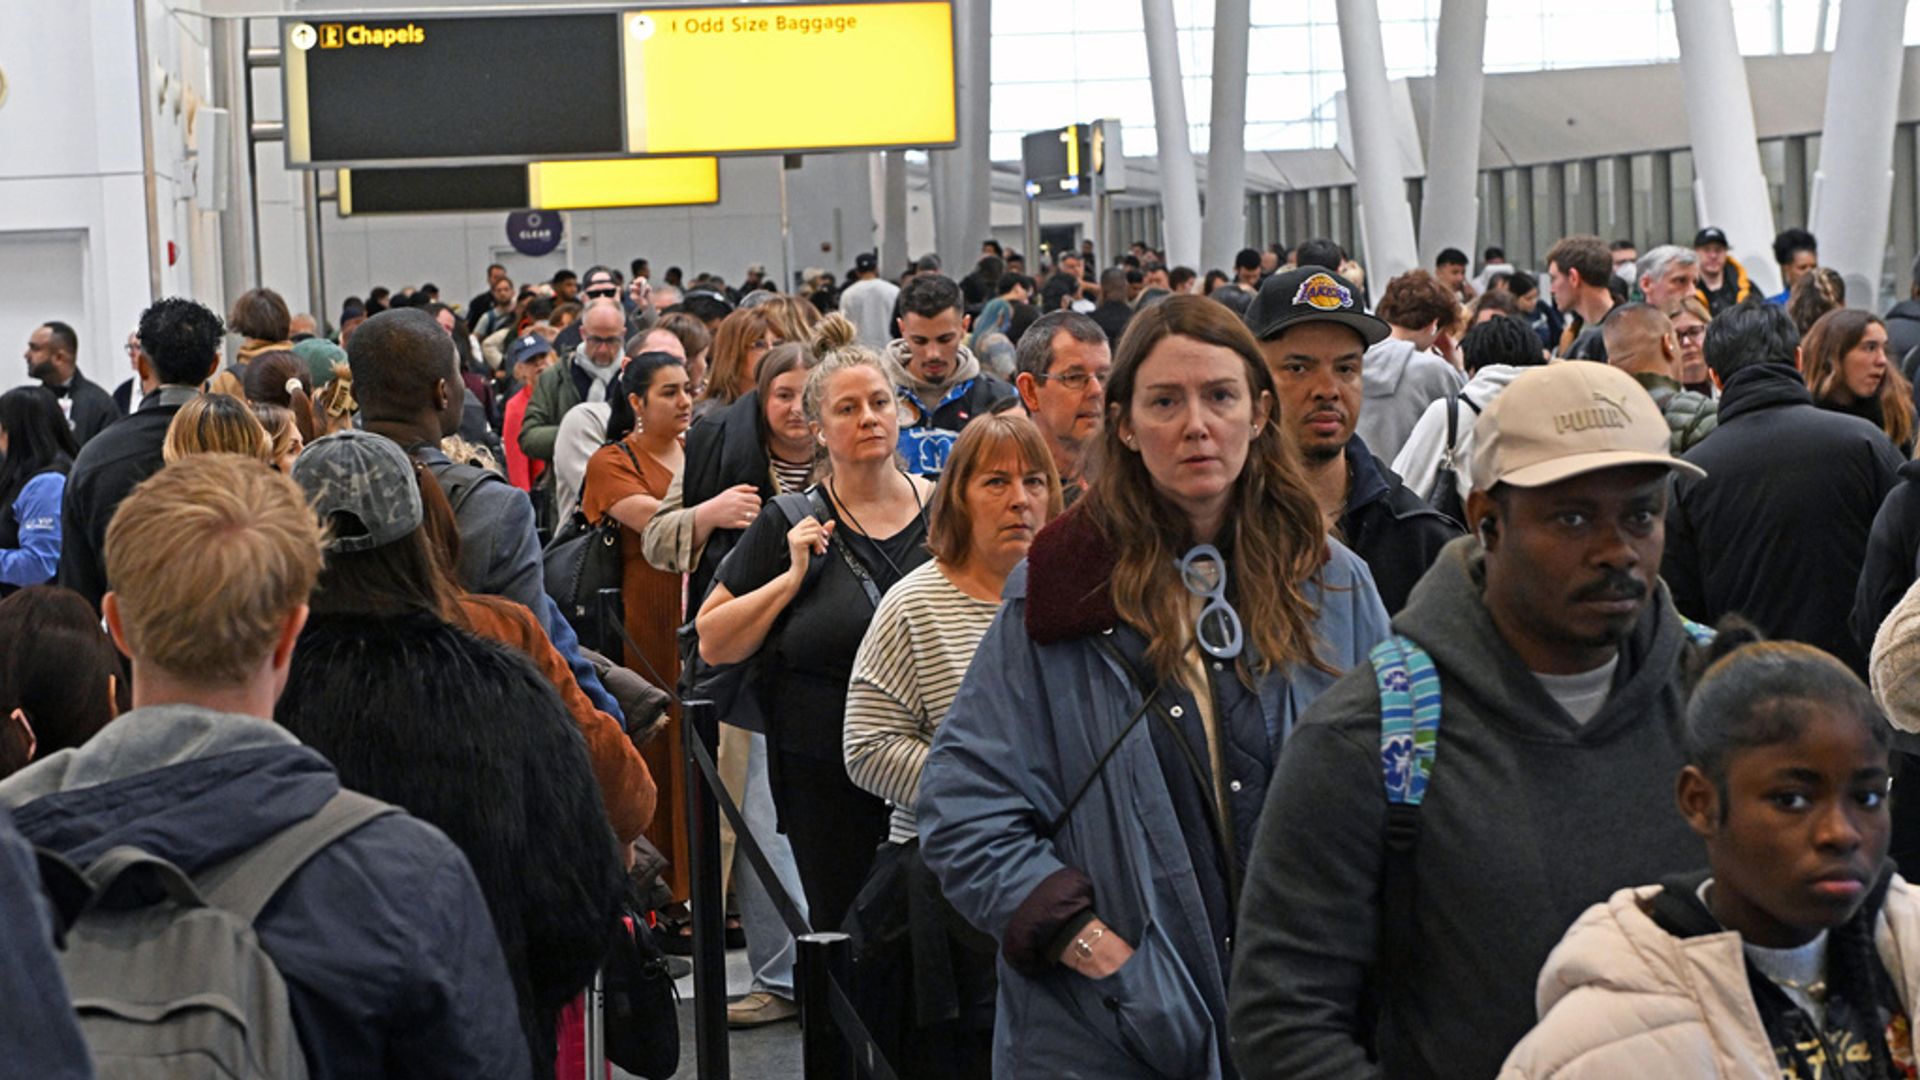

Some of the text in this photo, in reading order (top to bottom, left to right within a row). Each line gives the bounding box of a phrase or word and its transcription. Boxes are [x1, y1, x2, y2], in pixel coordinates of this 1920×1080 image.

[346, 23, 425, 48] Chapels
[685, 15, 857, 34] Odd Size Baggage
[519, 230, 551, 240] CLEAR
[1553, 407, 1625, 435] PUMA
